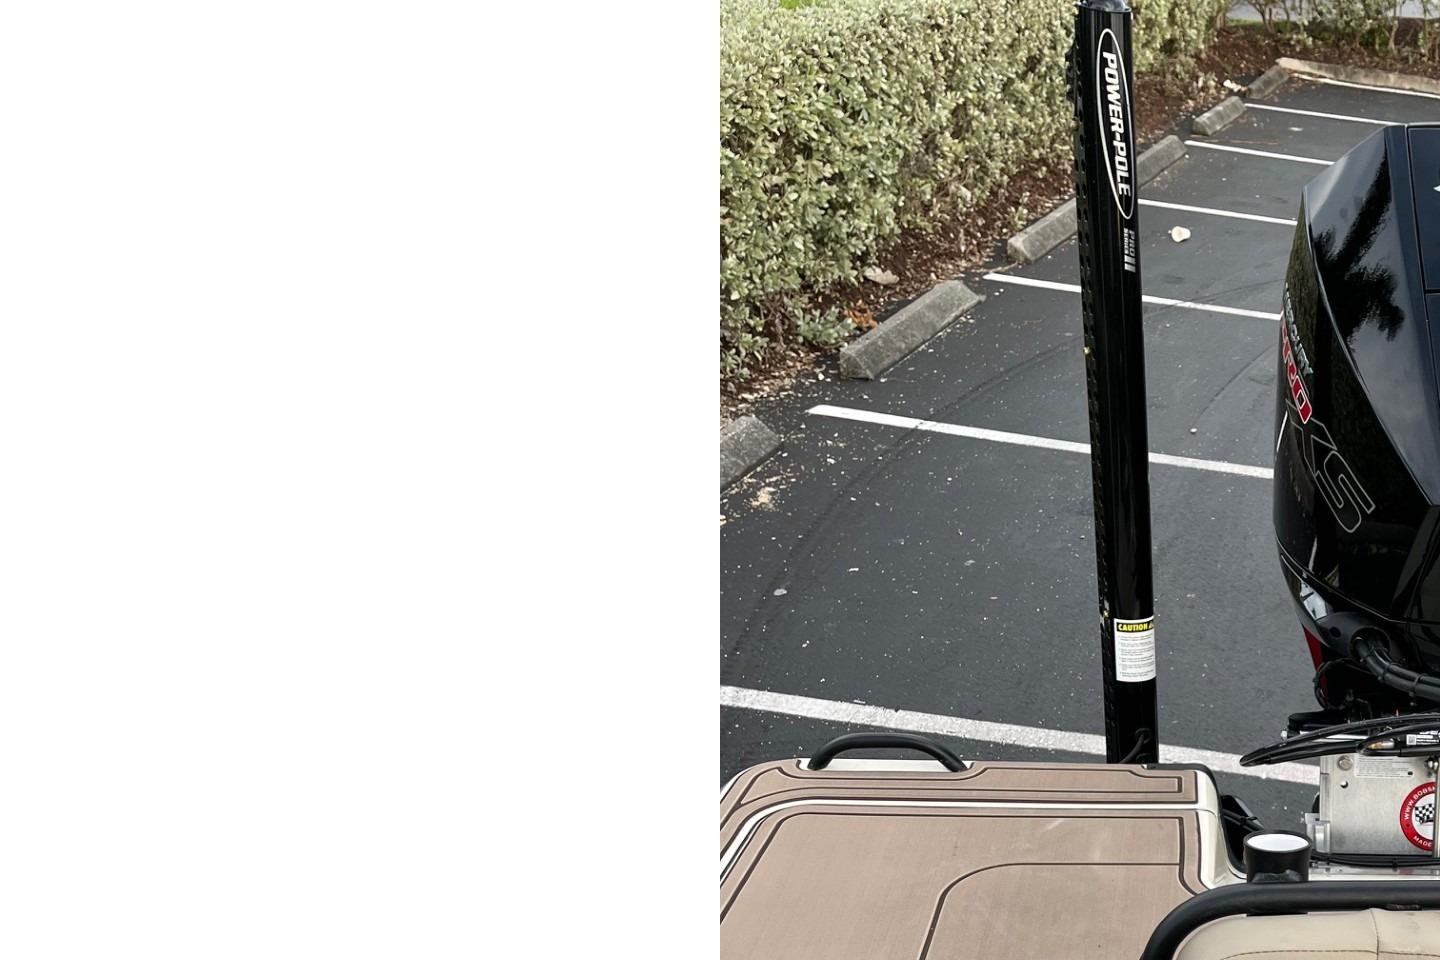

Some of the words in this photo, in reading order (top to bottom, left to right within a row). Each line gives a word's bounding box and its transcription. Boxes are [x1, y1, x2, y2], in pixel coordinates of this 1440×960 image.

[1102, 51, 1132, 197] POWER-POLE
[1118, 622, 1149, 632] CAUTION
[1413, 835, 1433, 848] MADE
